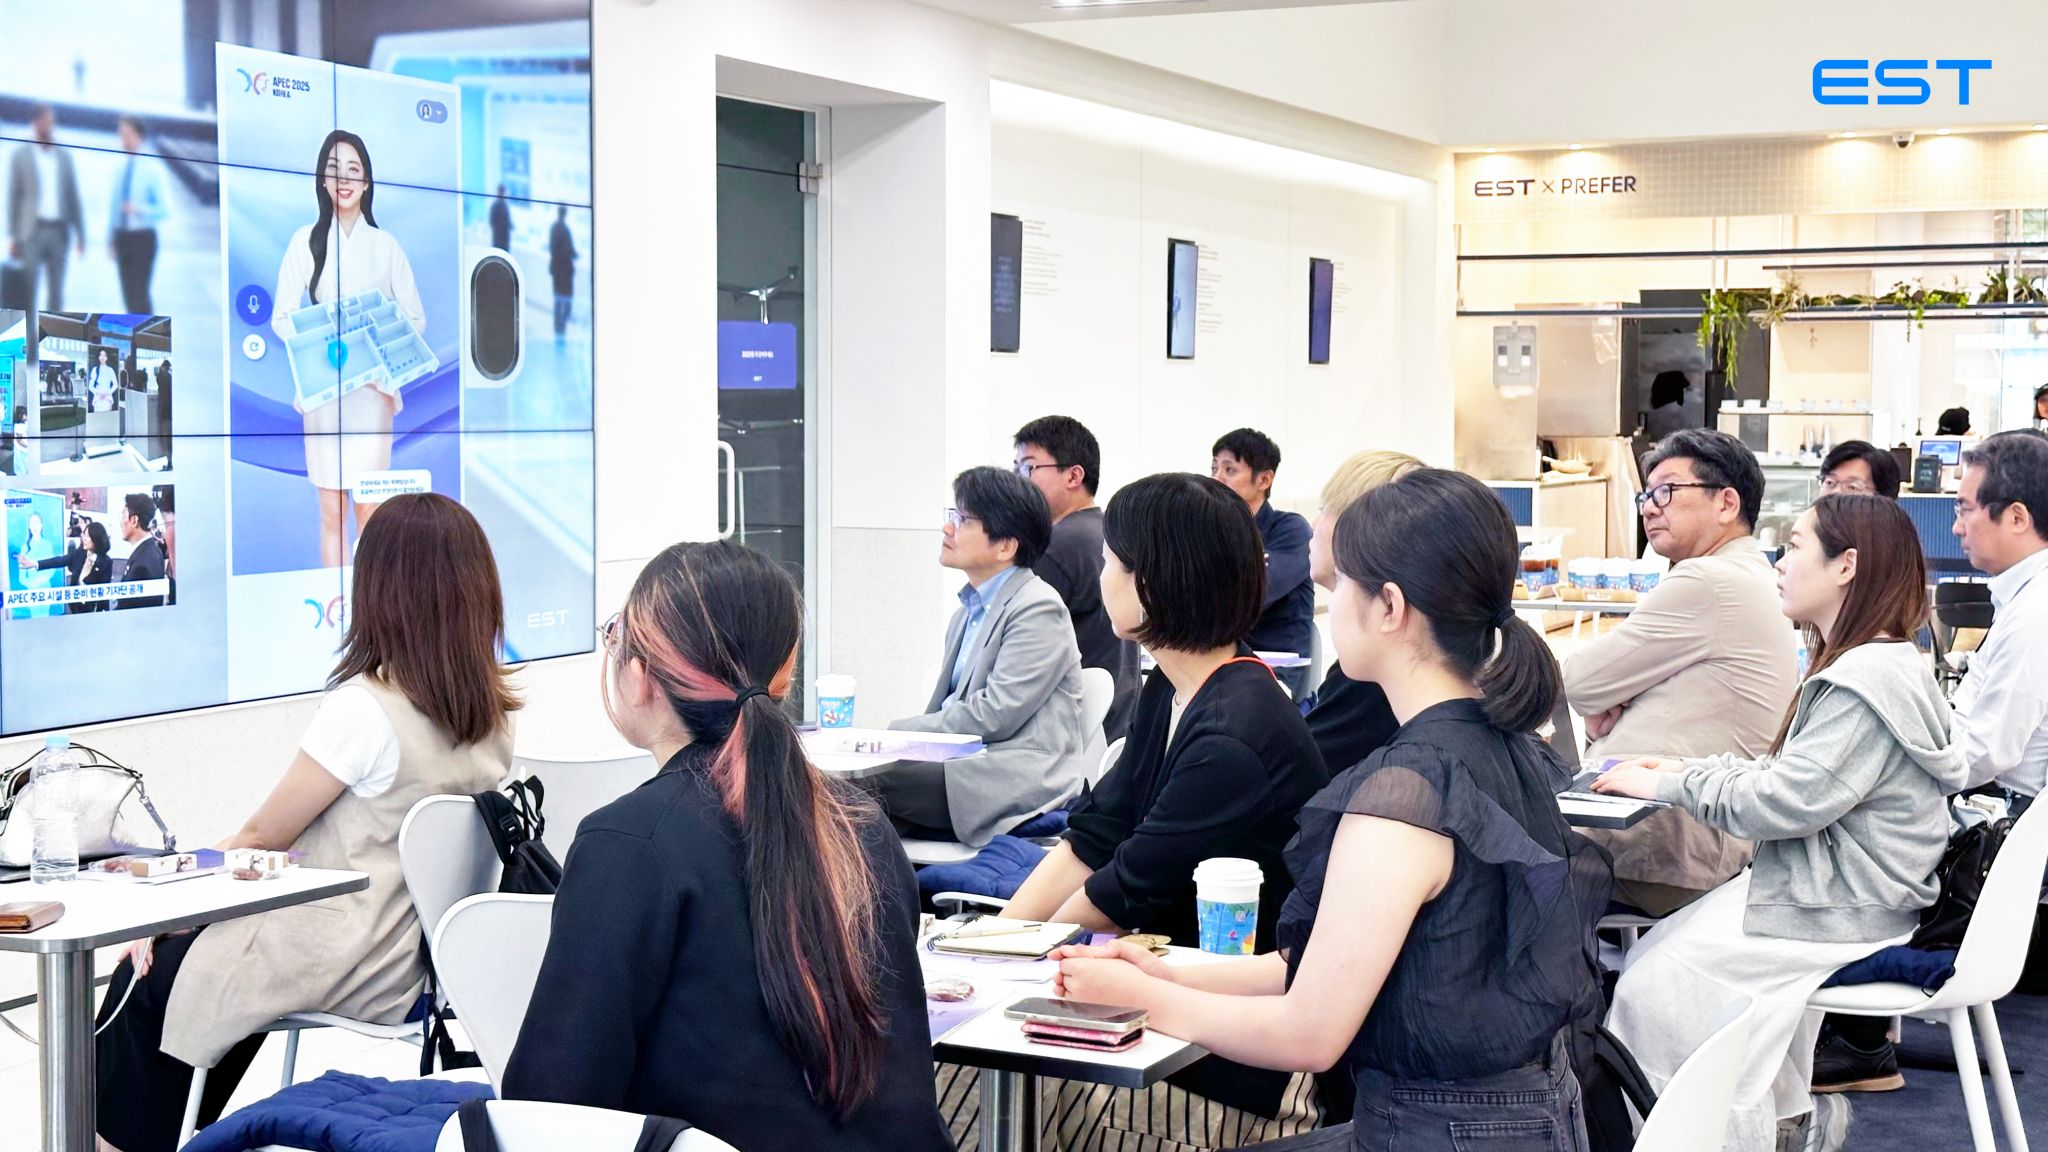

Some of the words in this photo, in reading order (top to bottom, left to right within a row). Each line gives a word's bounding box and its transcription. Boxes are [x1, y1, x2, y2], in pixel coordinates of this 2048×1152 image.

[273, 76, 290, 88] APEC
[292, 79, 310, 91] 2025
[1474, 179, 1536, 197] EST
[1561, 175, 1637, 195] PREFER
[7, 592, 29, 604] APEC
[30, 590, 46, 603] 주요
[47, 589, 63, 602] 시설
[64, 589, 71, 600] 등
[73, 587, 88, 600] 준비
[105, 584, 128, 597] 기자단
[129, 583, 144, 595] 공개
[527, 609, 569, 628] EST
